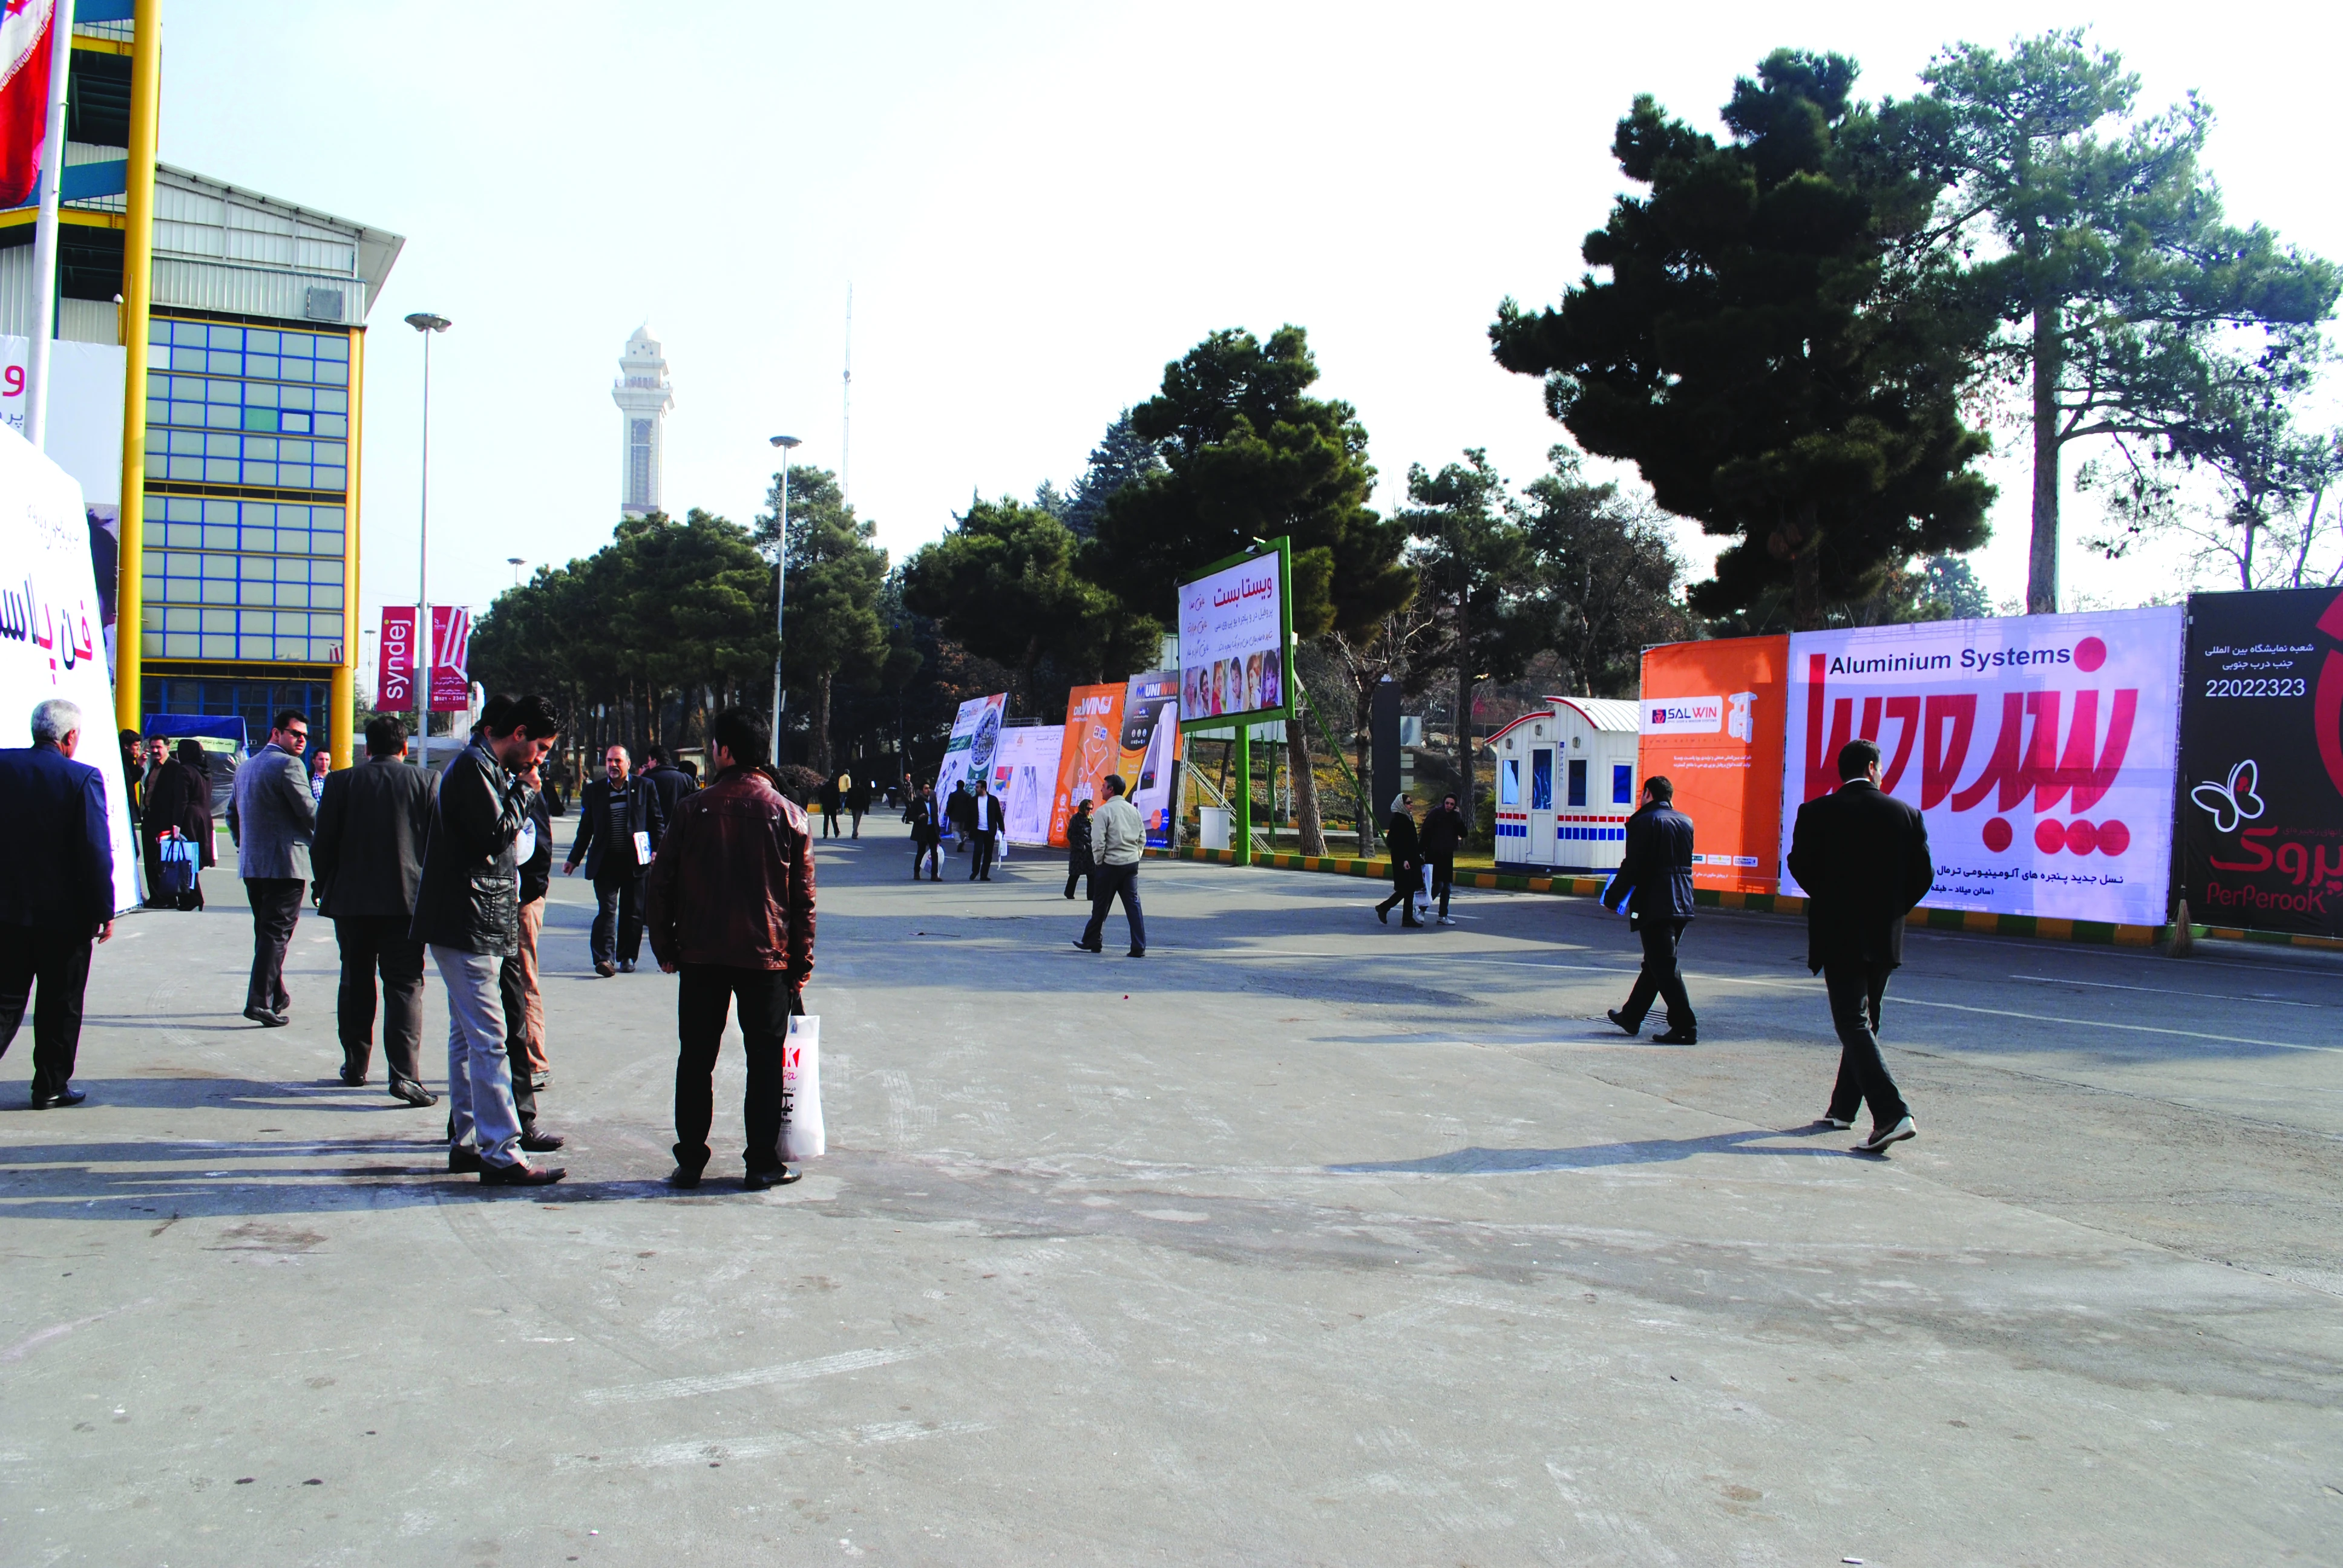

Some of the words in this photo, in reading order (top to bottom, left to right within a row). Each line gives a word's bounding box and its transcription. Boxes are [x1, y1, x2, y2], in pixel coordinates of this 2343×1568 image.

[2204, 646, 2230, 656] المللی
[2232, 647, 2248, 656] بین
[2250, 644, 2287, 655] نمایشگاه
[2290, 643, 2314, 654] شعبه
[384, 619, 412, 699] syndej
[1829, 651, 1951, 675] Aluminium
[1960, 645, 2072, 672] Systems
[2222, 661, 2249, 670] جنوبی
[2250, 661, 2270, 670] درب
[2272, 660, 2293, 669] جنب
[2205, 678, 2305, 697] 22022323
[1936, 865, 1961, 877] ترمال
[1963, 867, 2019, 879] آلومینیومی
[2022, 870, 2038, 881] های
[2040, 872, 2068, 884] پنجره
[2071, 875, 2097, 885] جدید
[2099, 876, 2124, 886] نسل
[1930, 884, 1947, 893] طبقه
[1955, 886, 1971, 895] میلاد
